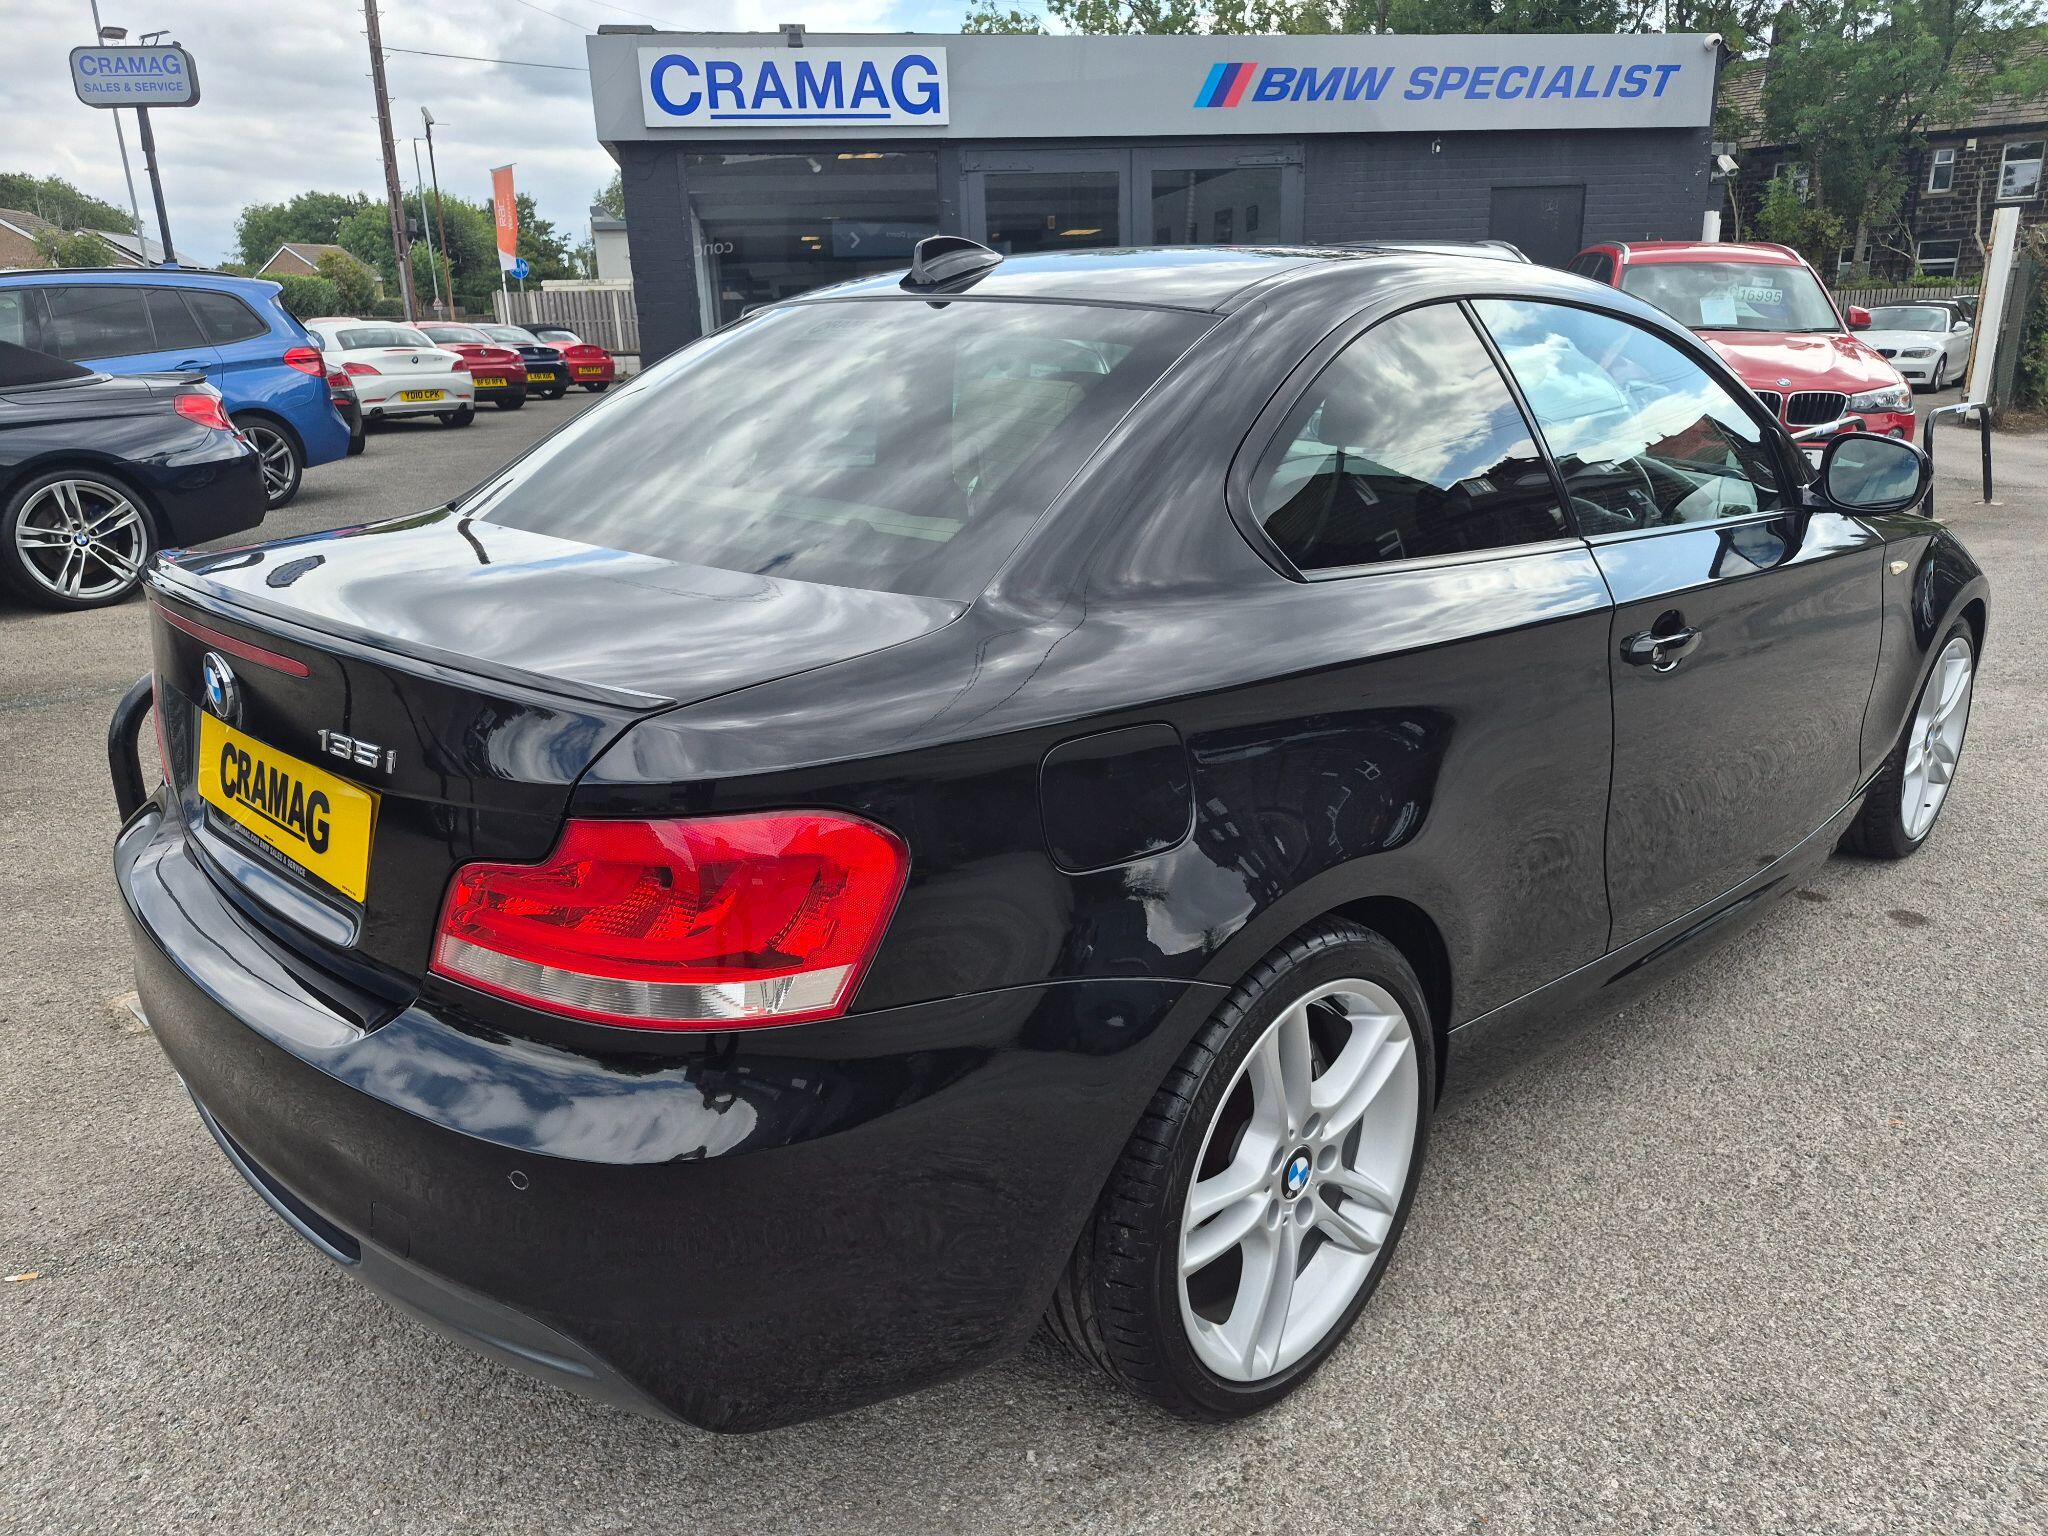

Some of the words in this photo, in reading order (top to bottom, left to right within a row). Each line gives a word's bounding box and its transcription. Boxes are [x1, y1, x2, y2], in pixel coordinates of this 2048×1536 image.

[79, 54, 181, 76] CRAMAG
[84, 82, 120, 93] SALES
[124, 82, 131, 92] &
[135, 81, 183, 92] SERVICE
[650, 54, 940, 116] CRAMAG
[1252, 67, 1396, 102] BMW
[1403, 63, 1682, 101] SPECIALIST
[424, 389, 440, 399] CPK
[220, 741, 330, 854] CRAMAG
